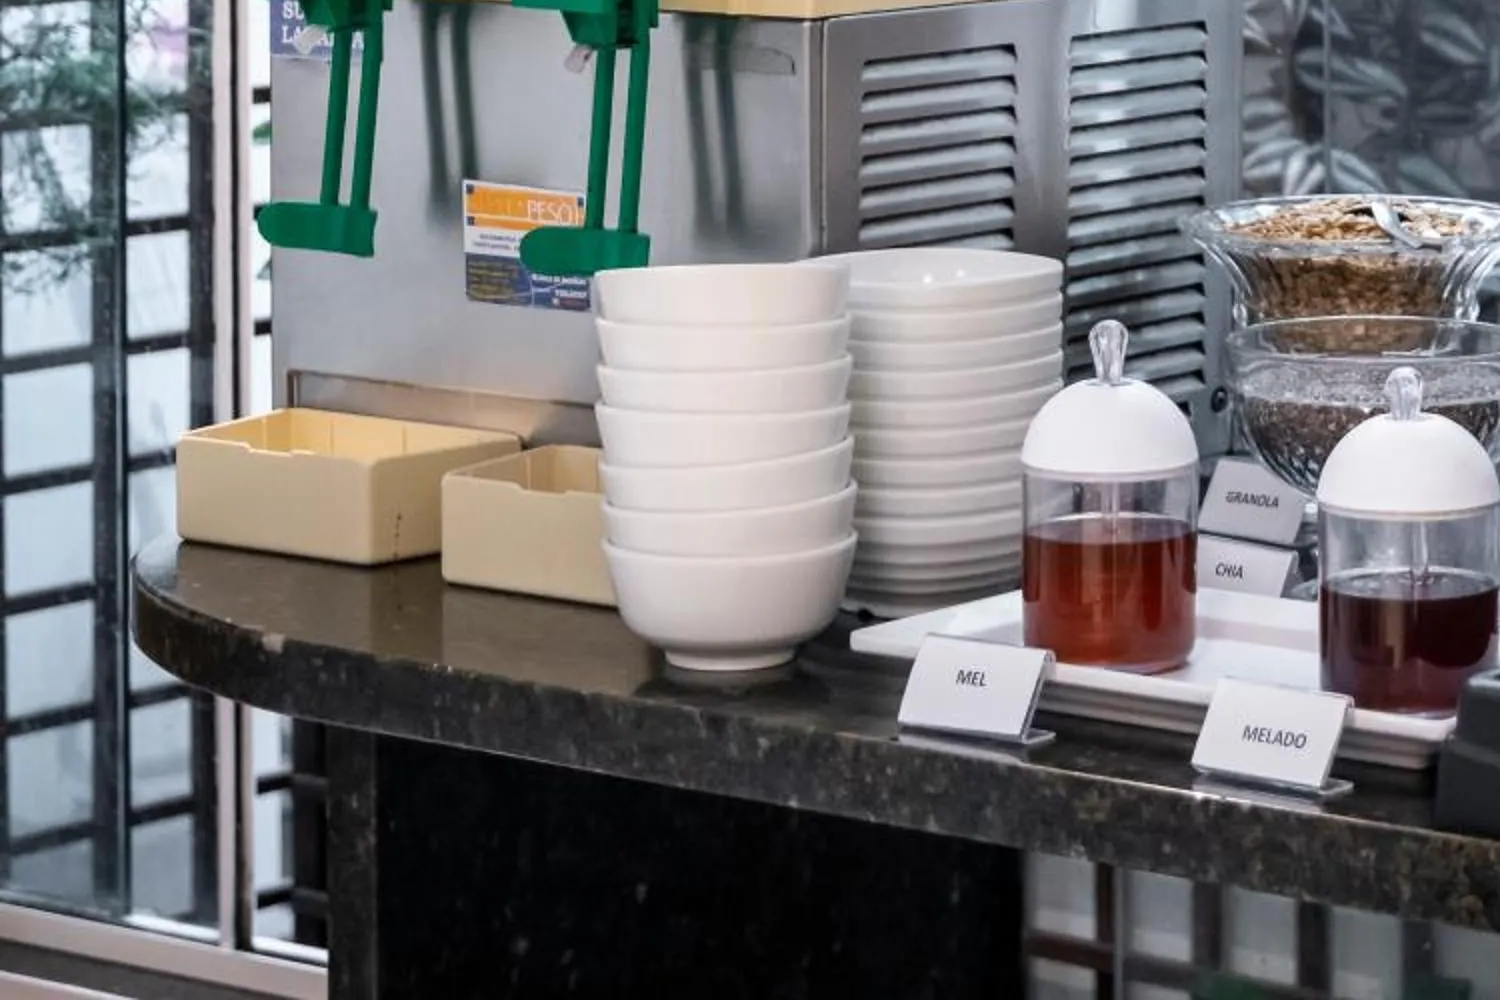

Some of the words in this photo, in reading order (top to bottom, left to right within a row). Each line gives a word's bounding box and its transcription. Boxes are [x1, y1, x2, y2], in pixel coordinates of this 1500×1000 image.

[1225, 490, 1280, 508] GRANOLA
[1215, 563, 1243, 578] CHIA
[955, 669, 988, 687] MEL
[1242, 724, 1308, 749] MELADO
